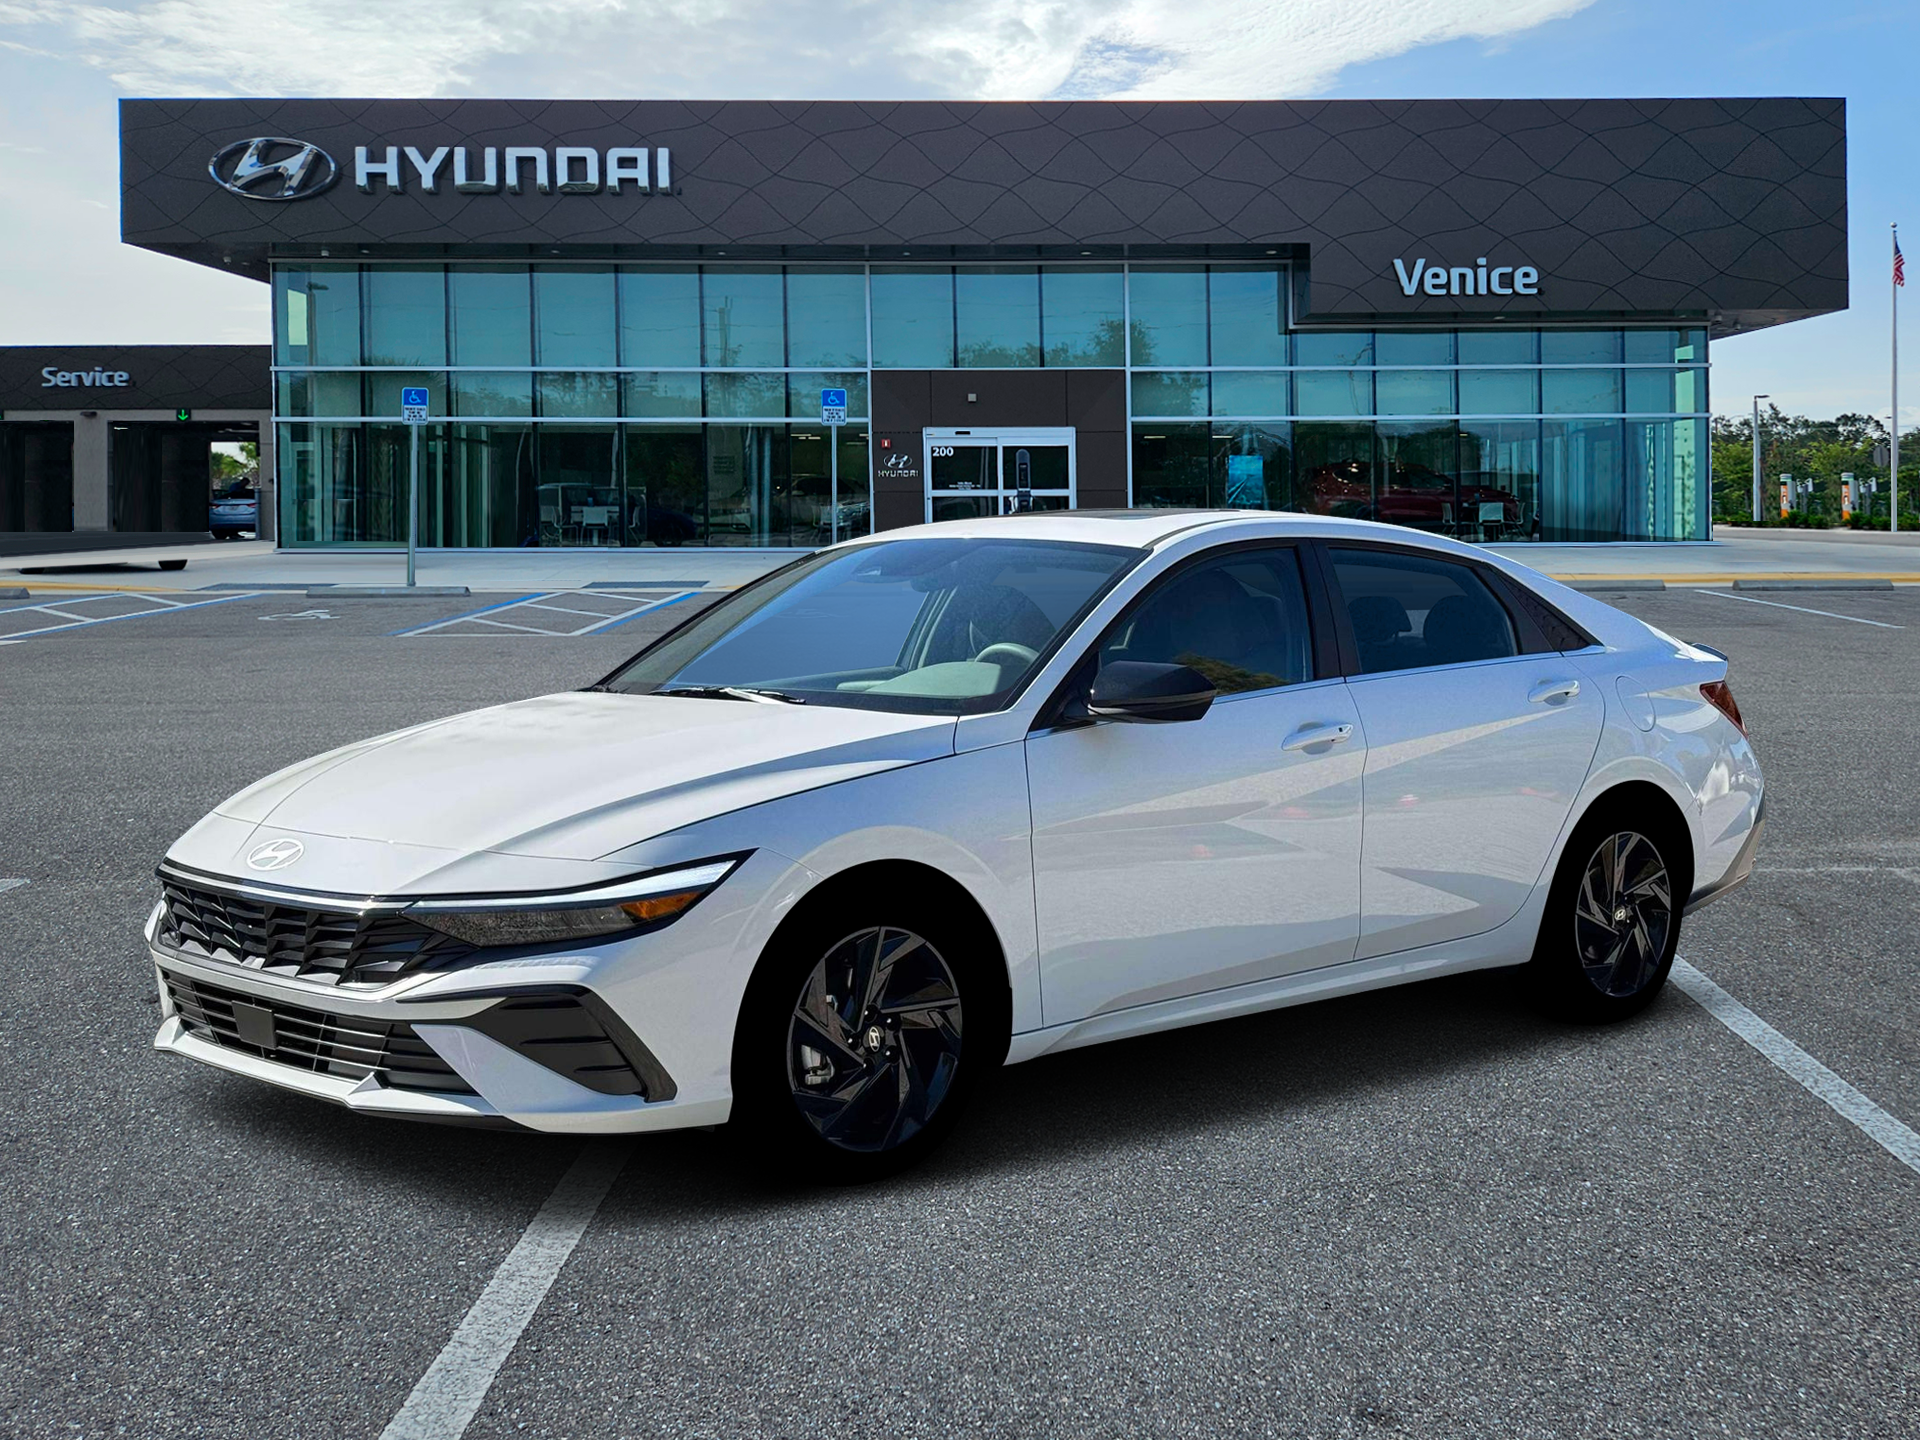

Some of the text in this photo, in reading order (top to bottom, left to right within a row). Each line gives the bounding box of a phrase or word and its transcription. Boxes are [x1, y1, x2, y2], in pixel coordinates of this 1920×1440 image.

[354, 146, 672, 194] HYUNDAI
[1393, 257, 1539, 296] Venice
[41, 366, 130, 387] Service
[932, 446, 954, 457] 200
[877, 469, 920, 478] HYUNDAI
